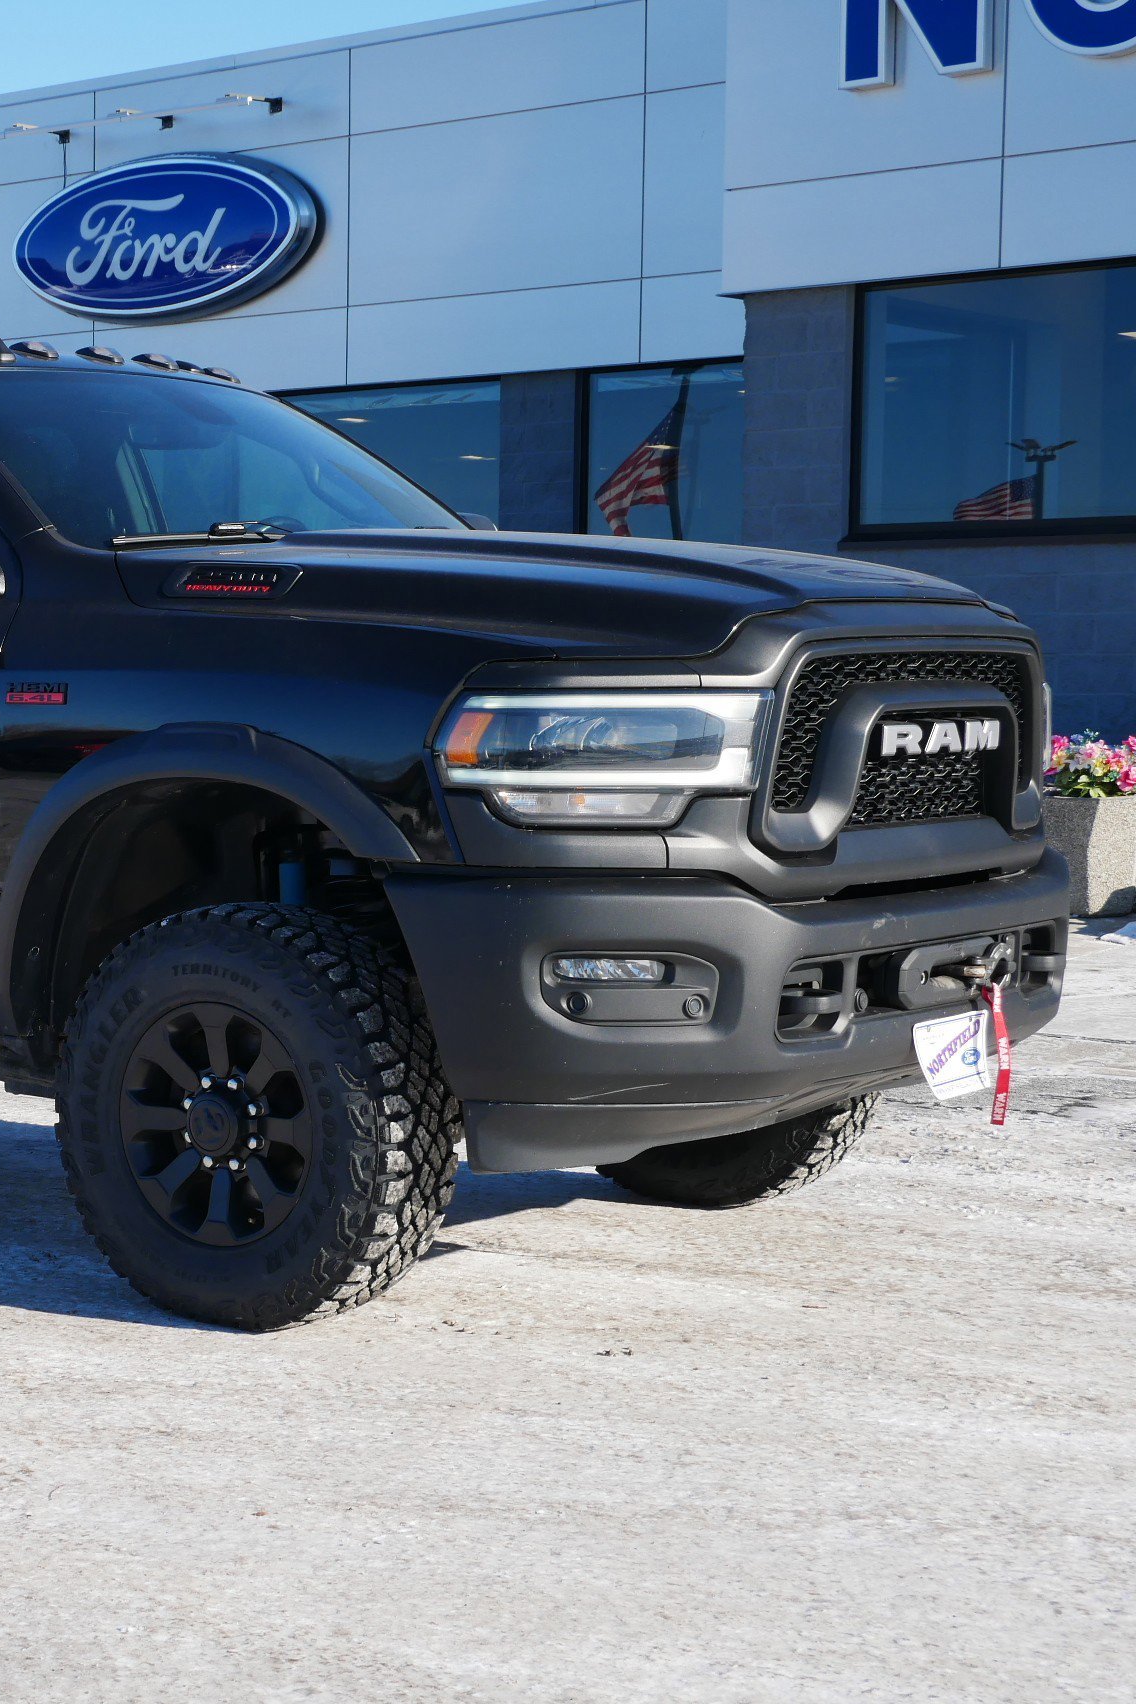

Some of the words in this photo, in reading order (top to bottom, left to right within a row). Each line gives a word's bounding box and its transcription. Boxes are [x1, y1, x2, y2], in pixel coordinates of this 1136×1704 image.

[66, 193, 226, 286] Ford
[7, 681, 69, 692] HEMI
[7, 692, 63, 703] 6.4L
[880, 719, 1001, 757] RAM
[171, 963, 263, 993] TERRITORY
[926, 1018, 981, 1080] NORTHFIELD
[998, 1037, 1010, 1070] WARN
[992, 1092, 1007, 1121] WARN
